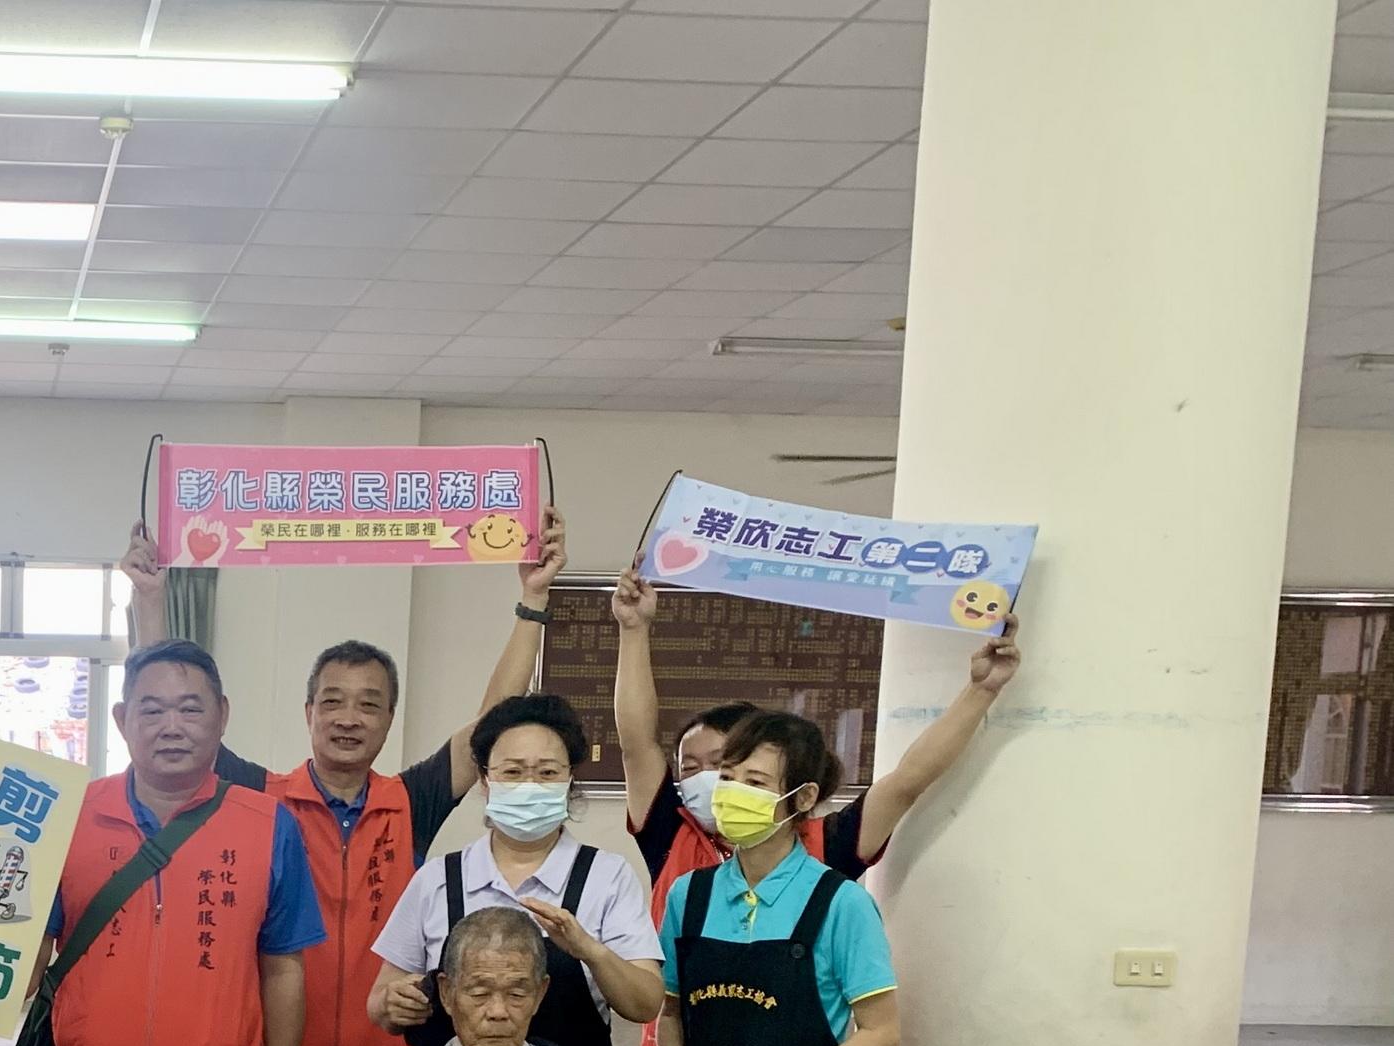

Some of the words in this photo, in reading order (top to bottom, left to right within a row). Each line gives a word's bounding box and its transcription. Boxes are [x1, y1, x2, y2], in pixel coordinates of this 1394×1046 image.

[175, 470, 522, 512] 彰化縣榮民服務處
[693, 507, 986, 575] 榮欣志工第二隊
[220, 848, 238, 908] 彰化縣
[197, 869, 217, 971] 榮民服務處
